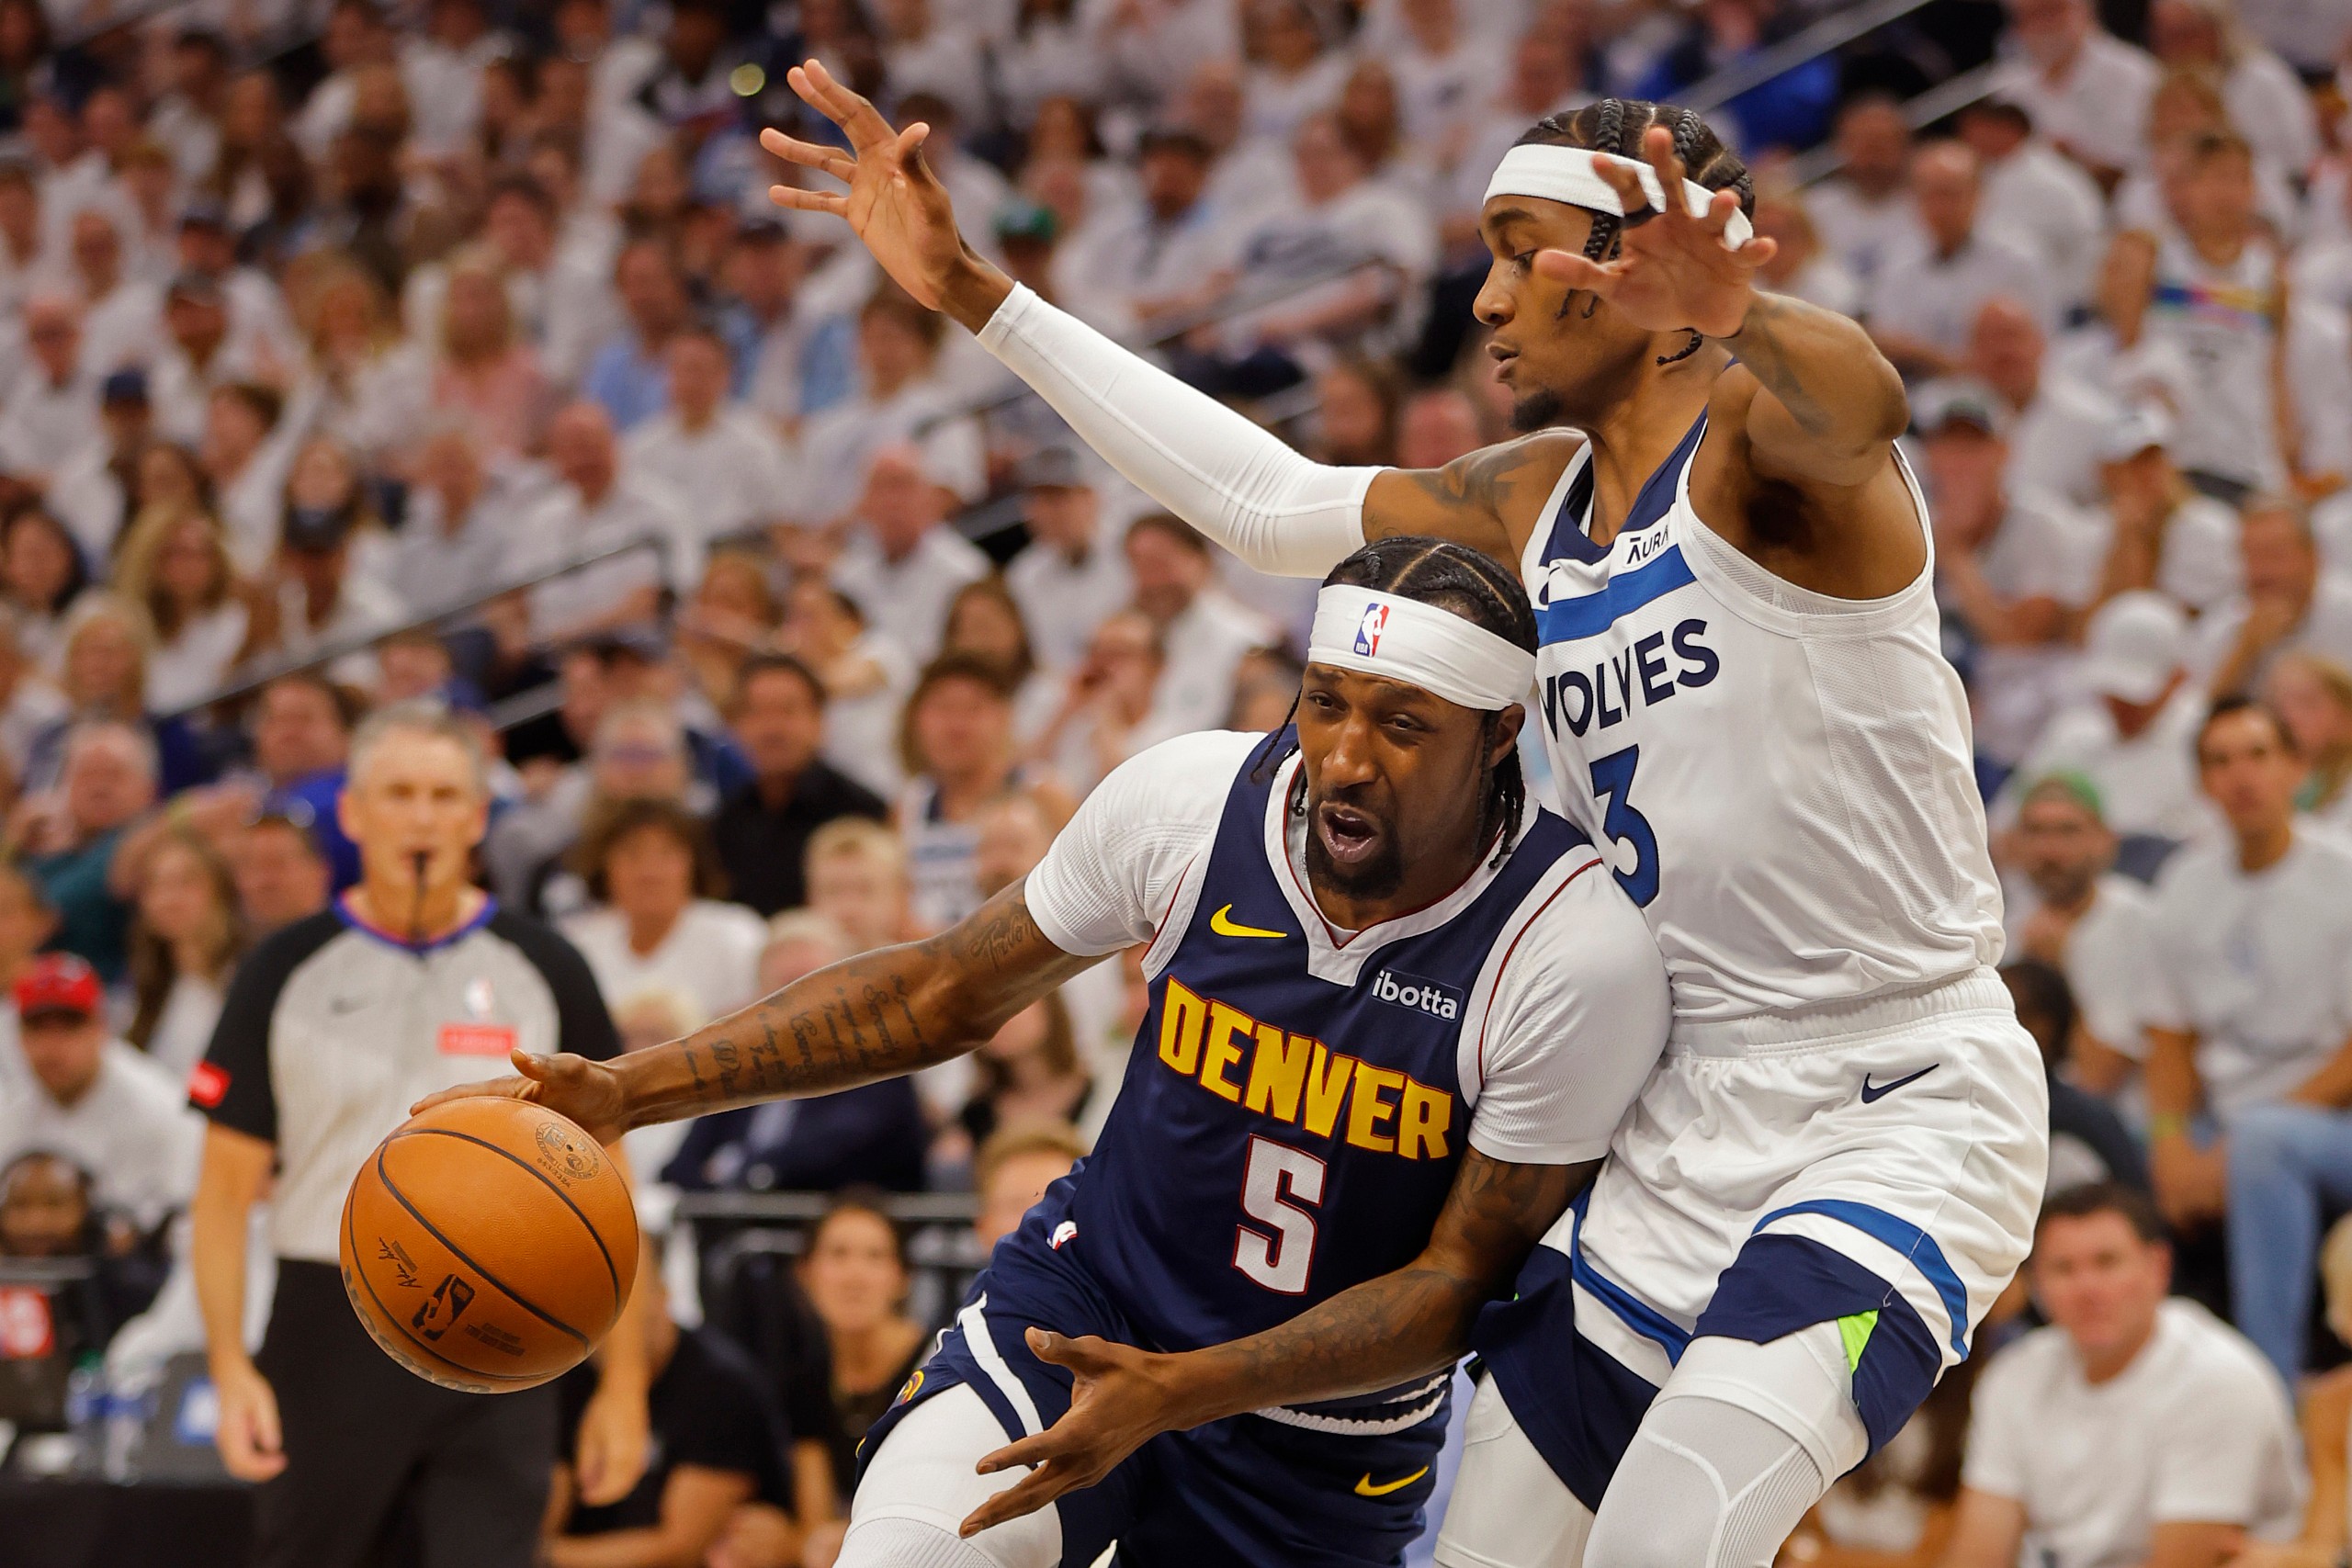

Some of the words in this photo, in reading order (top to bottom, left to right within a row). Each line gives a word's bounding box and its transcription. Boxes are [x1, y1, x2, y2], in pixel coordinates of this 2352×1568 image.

[1589, 743, 1660, 908] 3
[1158, 974, 1454, 1160] DENVER
[1371, 970, 1458, 1021] ibotta
[1231, 1133, 1328, 1295] 5
